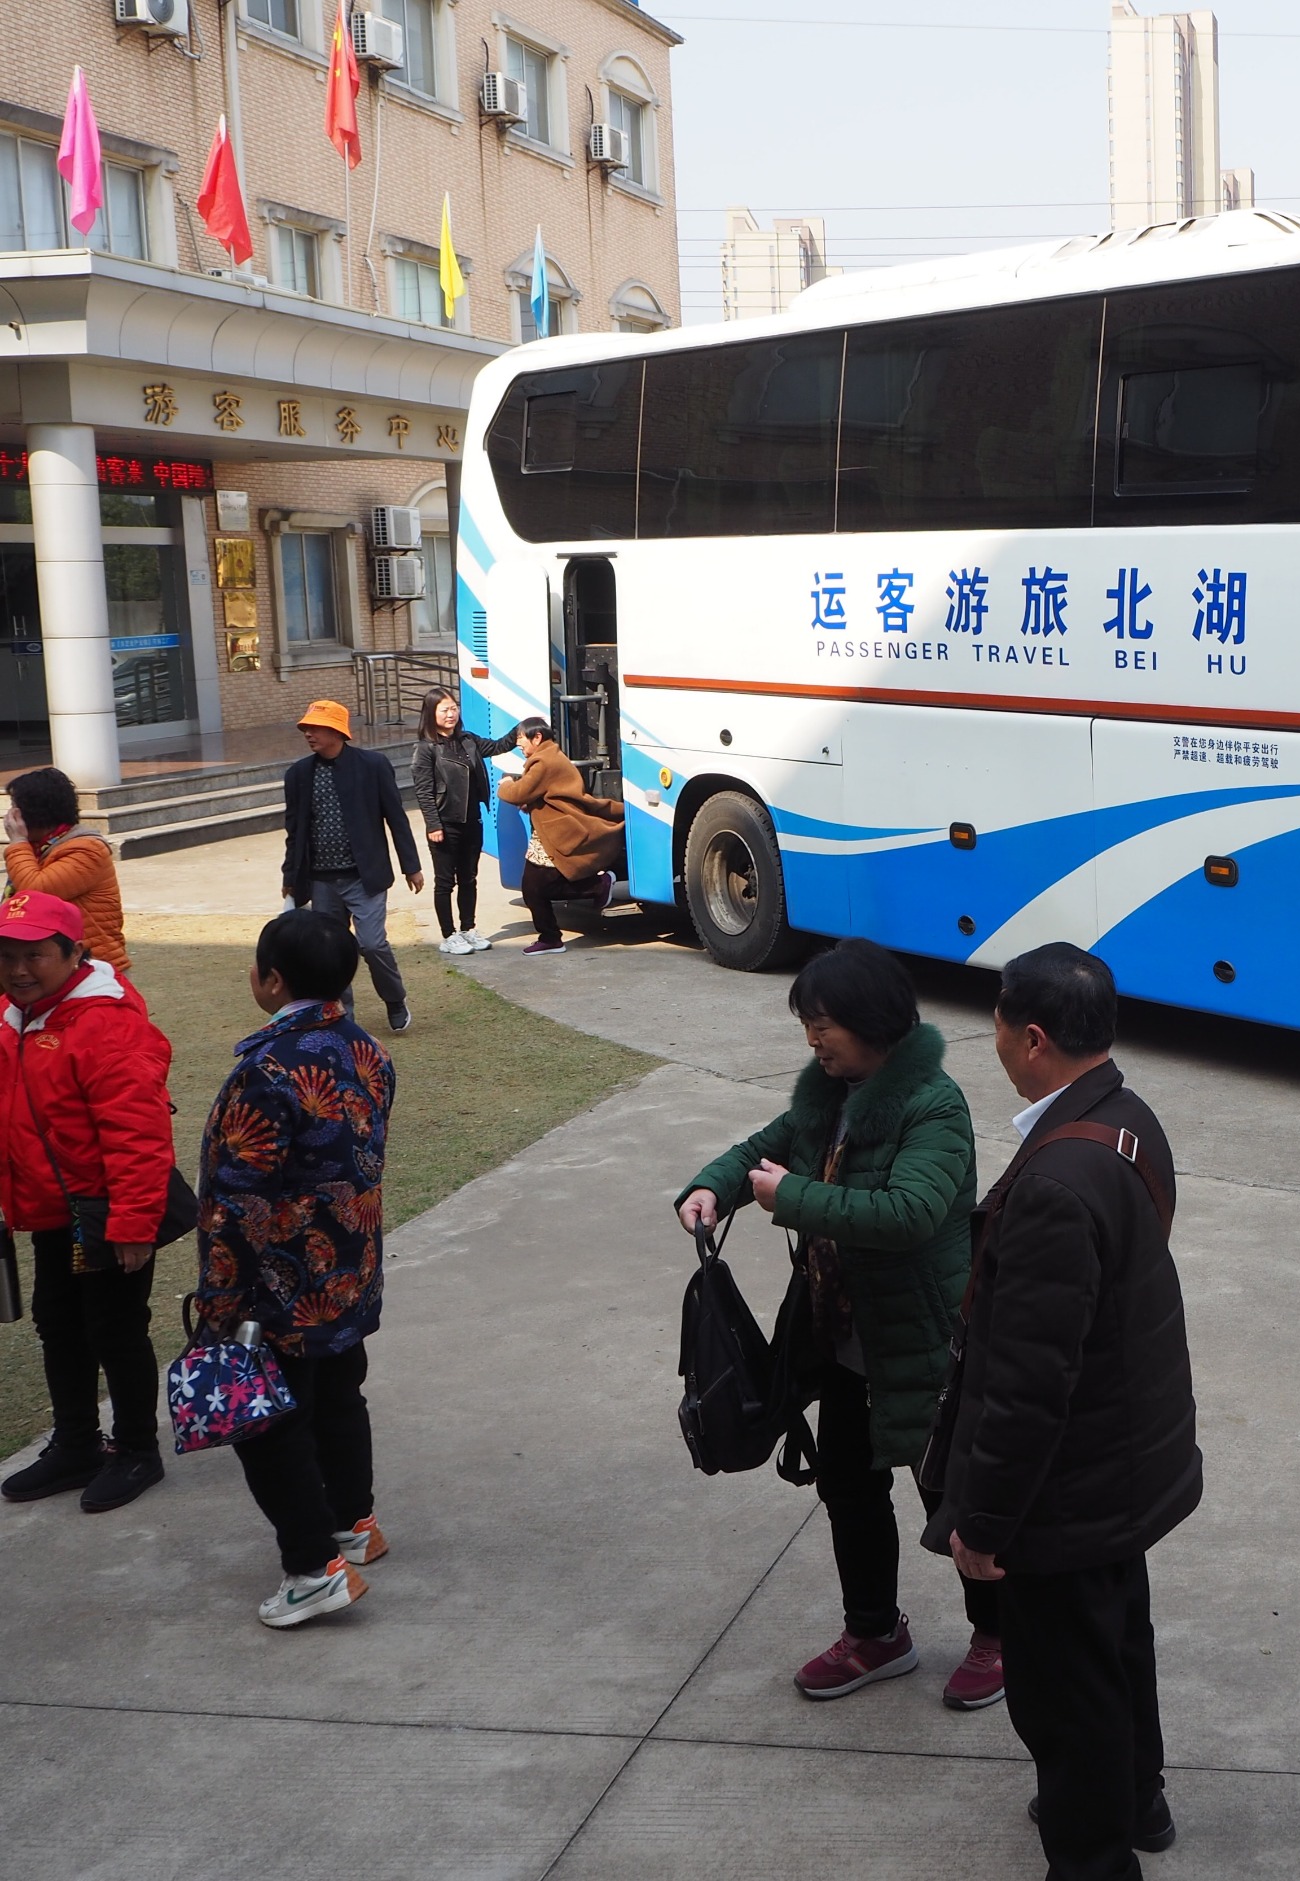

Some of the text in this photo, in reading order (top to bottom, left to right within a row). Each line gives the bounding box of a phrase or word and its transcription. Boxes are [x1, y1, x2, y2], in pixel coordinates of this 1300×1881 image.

[143, 383, 460, 452] 游客服务中心
[816, 641, 1247, 675] PASSENGER TRAVEL BEI HU
